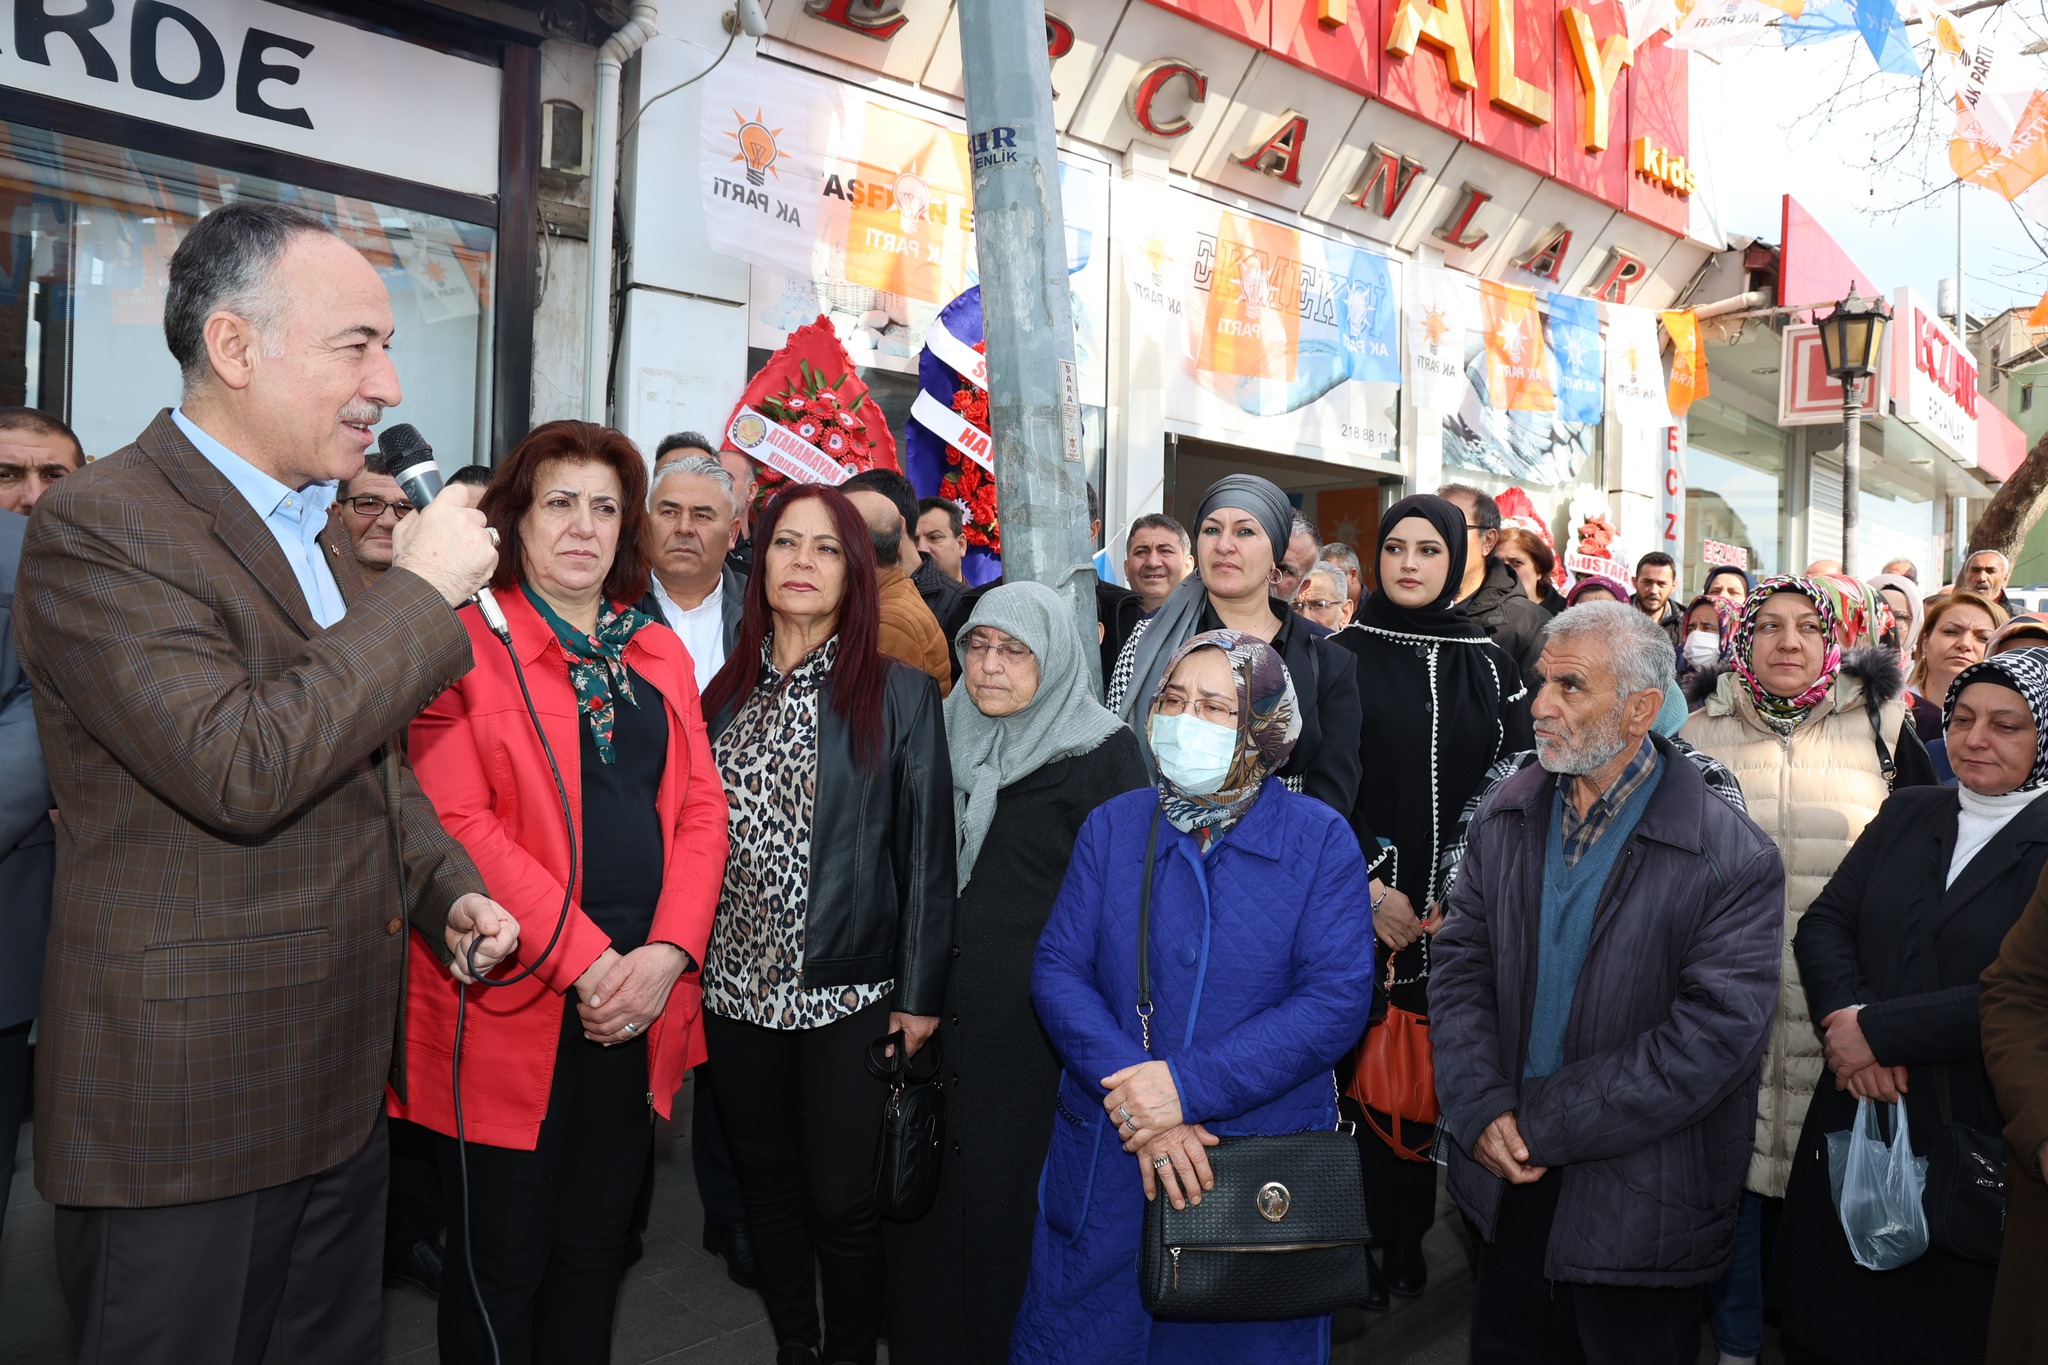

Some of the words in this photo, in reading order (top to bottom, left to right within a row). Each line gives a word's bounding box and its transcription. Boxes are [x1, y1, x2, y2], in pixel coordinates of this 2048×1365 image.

[1970, 44, 1995, 87] PARTİ
[1964, 83, 1982, 111] AK
[1634, 135, 1696, 195] kids
[1975, 158, 2005, 179] AK
[1341, 423, 1360, 439] 218
[1362, 428, 1375, 442] 88
[1377, 431, 1388, 445] 11
[765, 427, 842, 484] ATANAMAYAN
[1703, 540, 1748, 571] ECZANE
